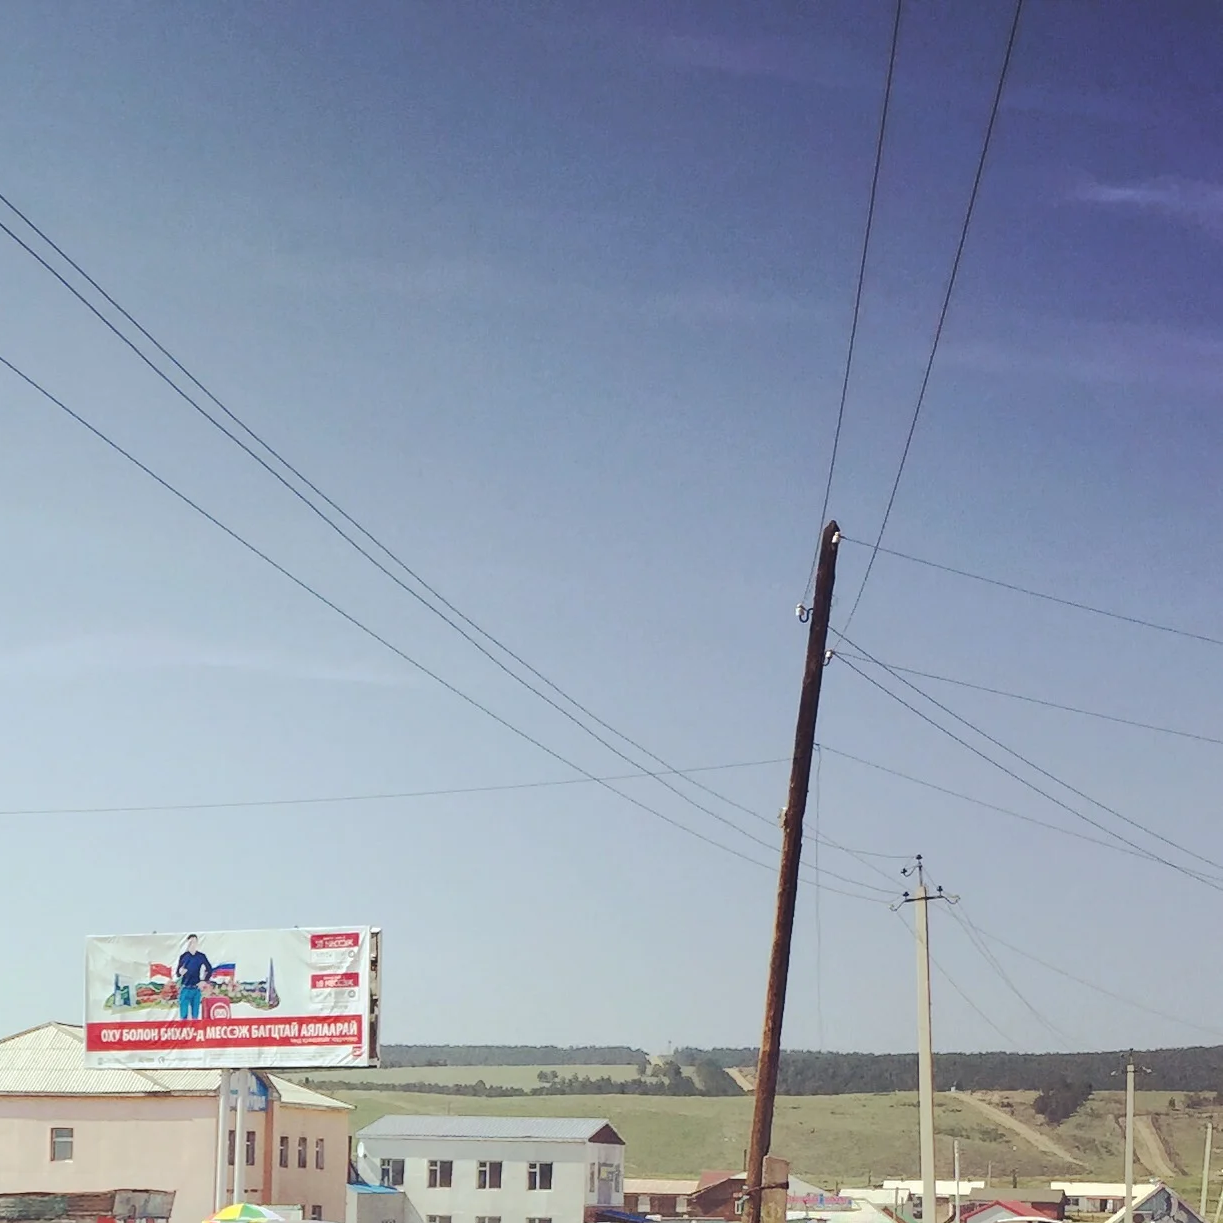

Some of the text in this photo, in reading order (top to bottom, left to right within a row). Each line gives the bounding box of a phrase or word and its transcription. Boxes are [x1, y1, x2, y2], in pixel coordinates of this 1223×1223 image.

[101, 1029, 121, 1042] ОХУ
[122, 1028, 158, 1041] БОЛОН
[206, 1025, 249, 1039] МЕССЭЖ
[251, 1021, 299, 1040] БАГЦТАЙ
[300, 1020, 358, 1037] АЯЛААРАЙ
